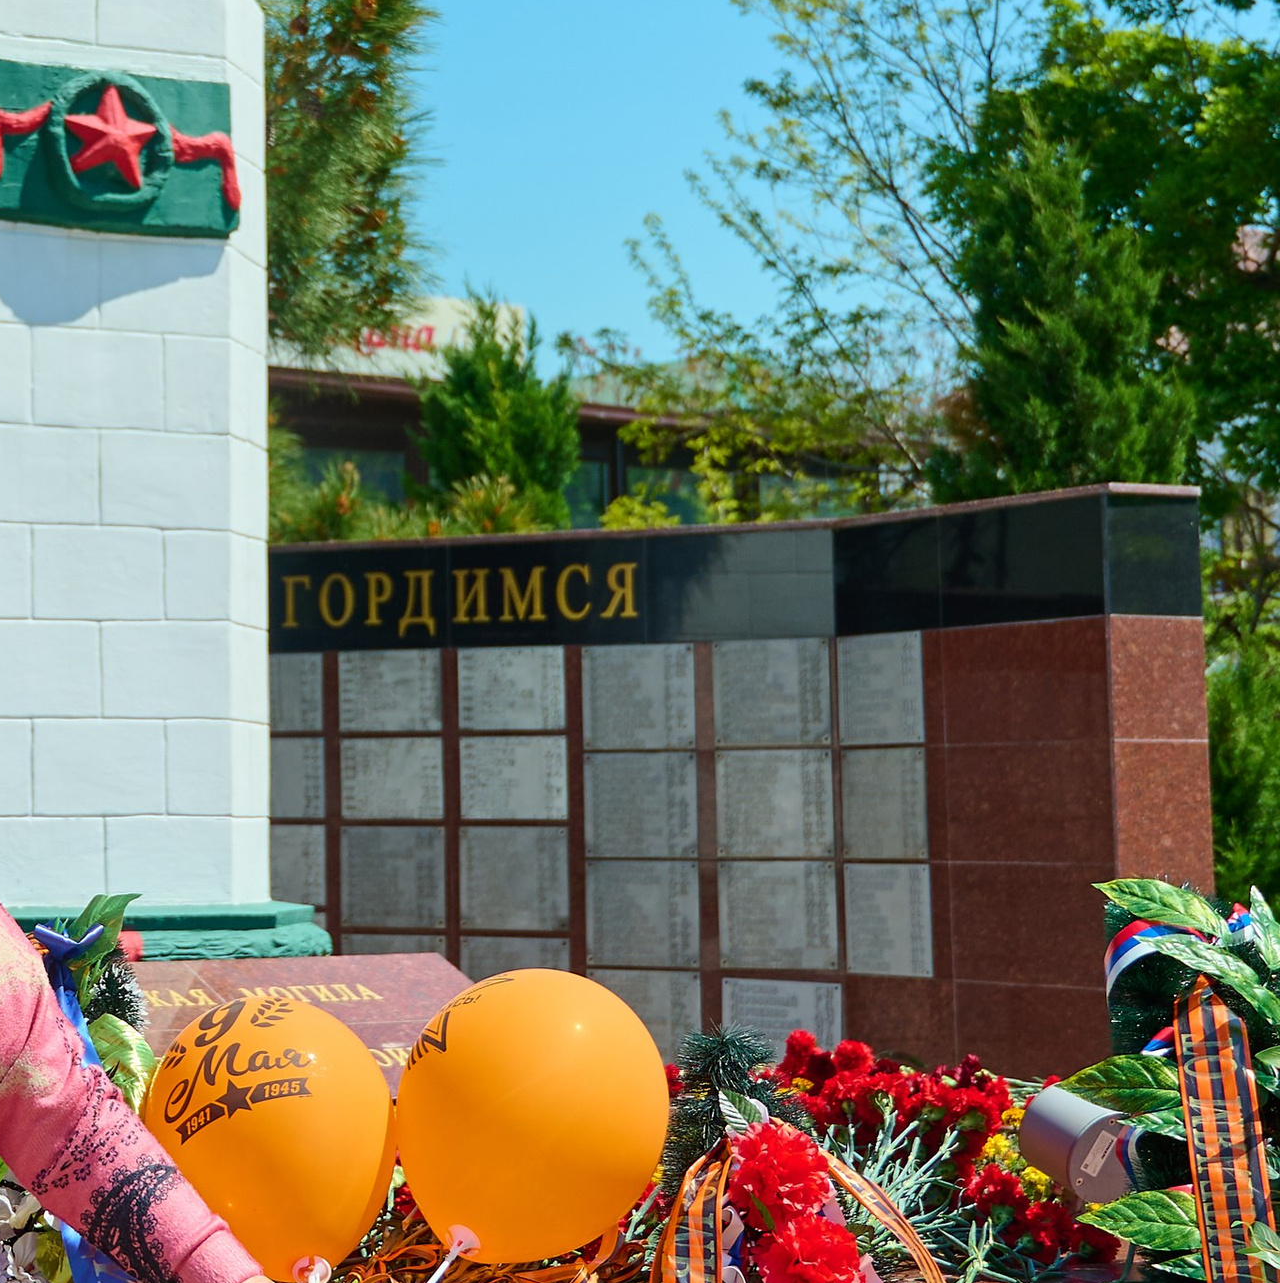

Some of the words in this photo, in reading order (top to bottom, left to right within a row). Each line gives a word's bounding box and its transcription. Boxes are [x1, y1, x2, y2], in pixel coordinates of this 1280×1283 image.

[281, 562, 639, 638] ГОРДИМСЯ
[194, 999, 247, 1048] 9
[163, 1041, 314, 1124] Мая
[1180, 1033, 1238, 1080] ОТ
[185, 1107, 212, 1136] 1941
[263, 1079, 301, 1098] 1945
